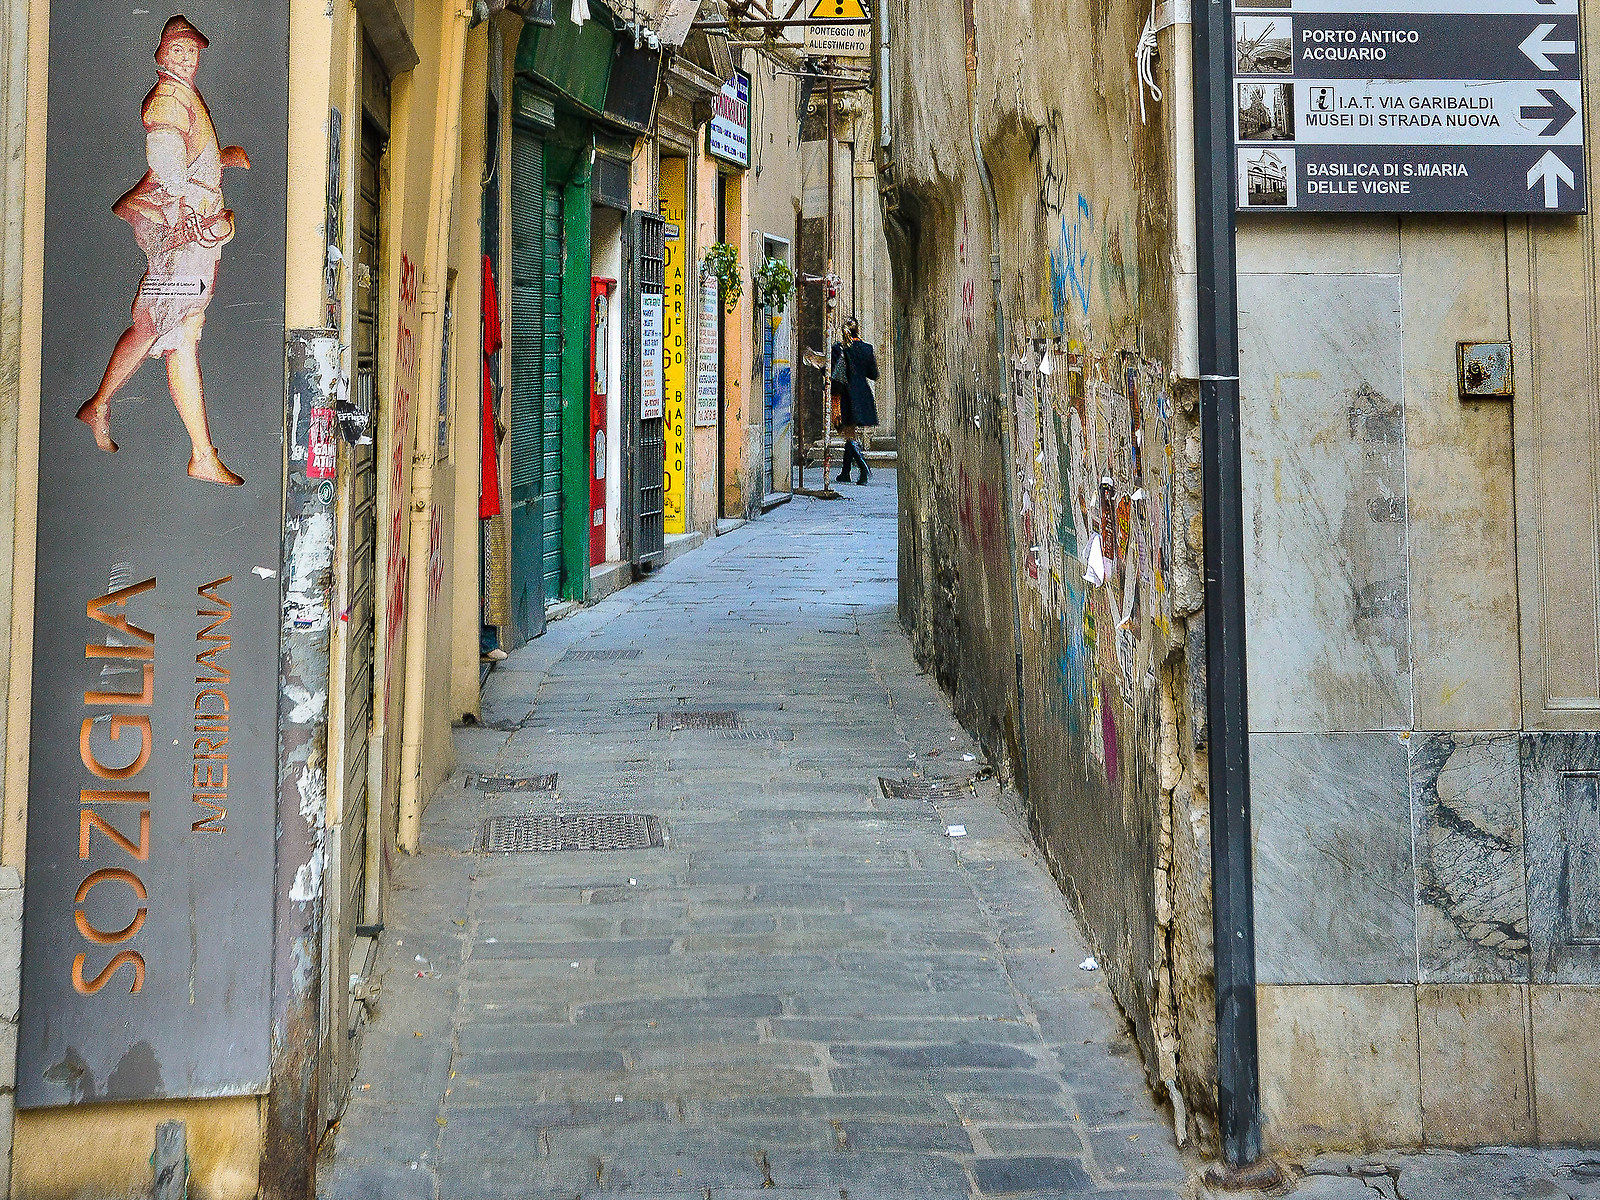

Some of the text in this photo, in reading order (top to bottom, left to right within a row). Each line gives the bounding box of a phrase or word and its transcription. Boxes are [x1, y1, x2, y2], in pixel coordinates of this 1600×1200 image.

[810, 26, 866, 38] PONTEGGIO IN
[1302, 29, 1419, 44] PORTO ANTICO
[808, 39, 866, 51] ALLESTIMENTO
[1302, 47, 1388, 61] ACQUARIO
[1339, 96, 1375, 110] I.A.T.
[1378, 96, 1407, 110] VIA
[1408, 96, 1494, 110] GARIBALDI
[1306, 113, 1501, 128] MUSEI DI STRADA NUOVA
[1306, 162, 1469, 178] BASILICA DI S.MARIA
[1307, 180, 1411, 195] DELLE VIGNE
[675, 390, 683, 472] BAGNO
[191, 574, 233, 836] MERIDIANA
[72, 576, 159, 995] SOZIGLIA
